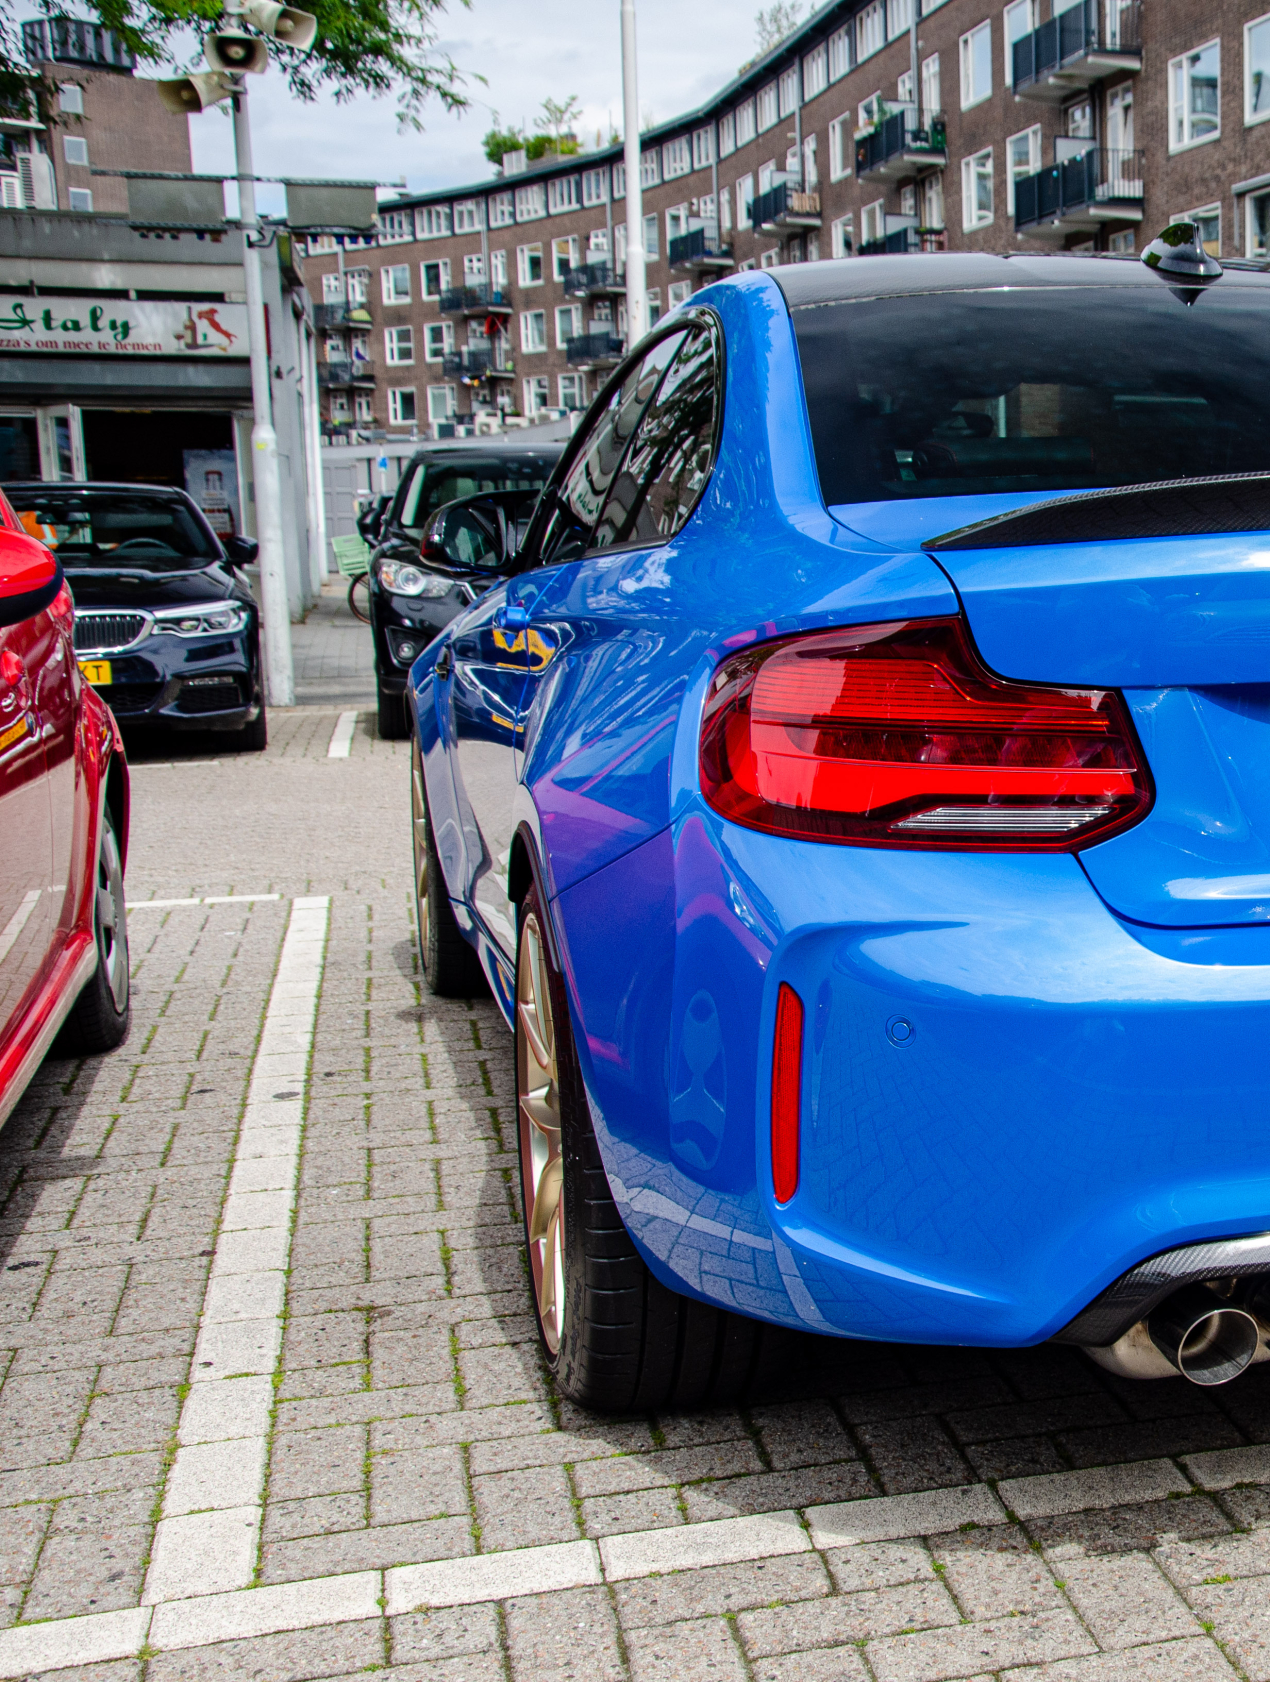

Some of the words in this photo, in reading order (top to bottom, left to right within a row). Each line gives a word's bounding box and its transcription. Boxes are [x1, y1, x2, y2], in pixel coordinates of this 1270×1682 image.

[0, 303, 137, 342] Italy
[36, 340, 59, 349] om
[63, 341, 93, 350] mee
[98, 340, 110, 351] te
[115, 341, 162, 351] nemen
